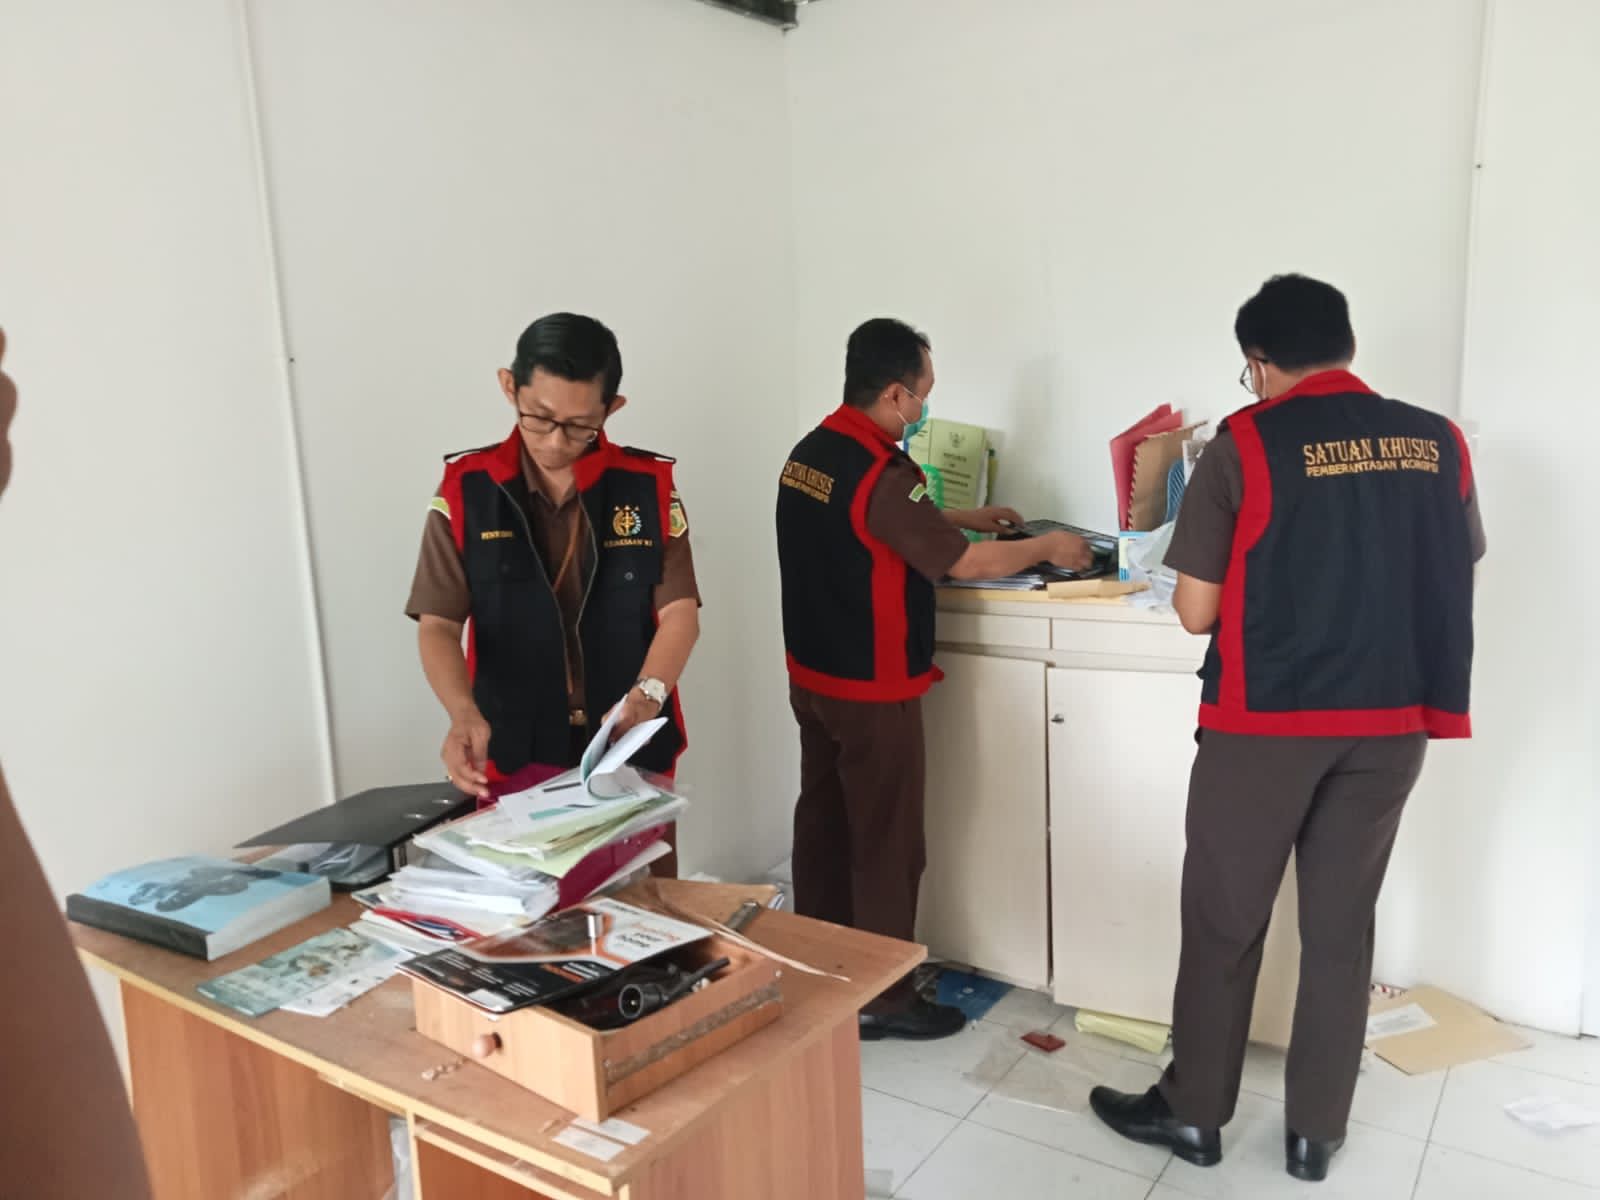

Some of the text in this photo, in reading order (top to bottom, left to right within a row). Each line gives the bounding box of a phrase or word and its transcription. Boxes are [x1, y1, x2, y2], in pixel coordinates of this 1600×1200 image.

[1303, 437, 1440, 465] SATUAN KHUSUS
[1305, 460, 1397, 477] PEMBERANTASAN
